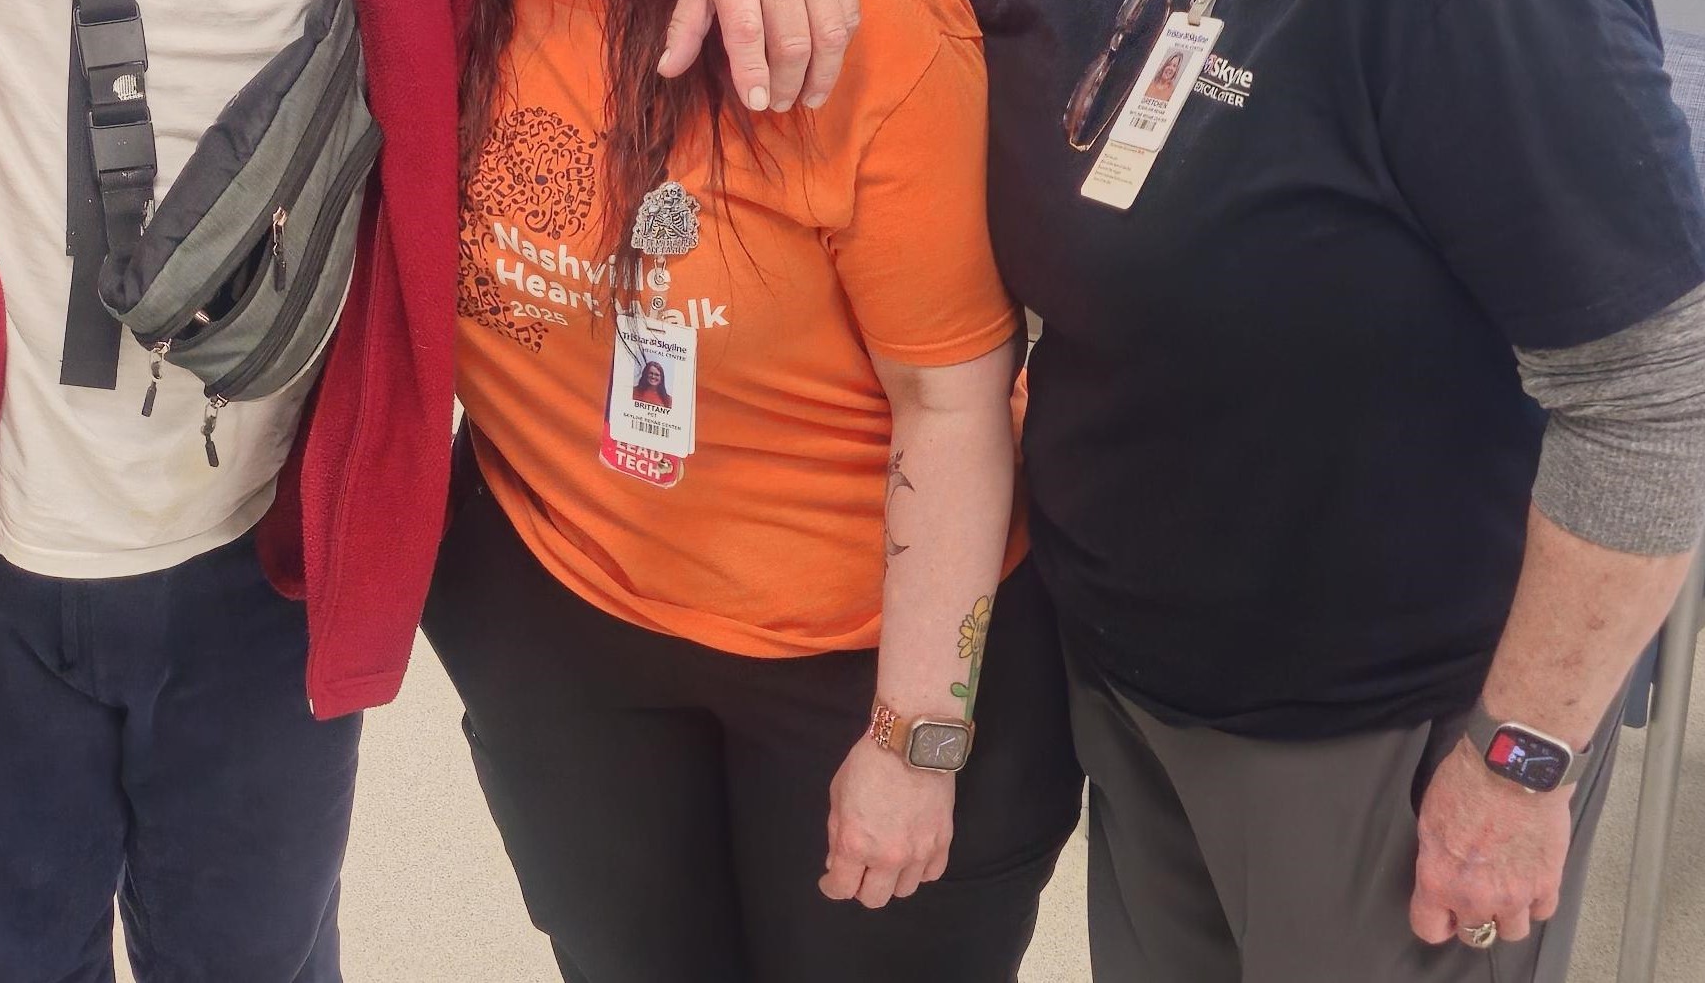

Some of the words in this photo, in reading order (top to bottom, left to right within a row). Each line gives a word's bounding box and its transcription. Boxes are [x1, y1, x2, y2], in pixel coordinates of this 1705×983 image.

[1194, 81, 1218, 99] EDICAL
[494, 222, 672, 292] Nashville
[496, 258, 604, 318] Heart
[509, 300, 568, 326] 2025
[657, 339, 688, 354] Skyline
[634, 401, 671, 415] BRITTANY
[615, 449, 661, 479] TECH
